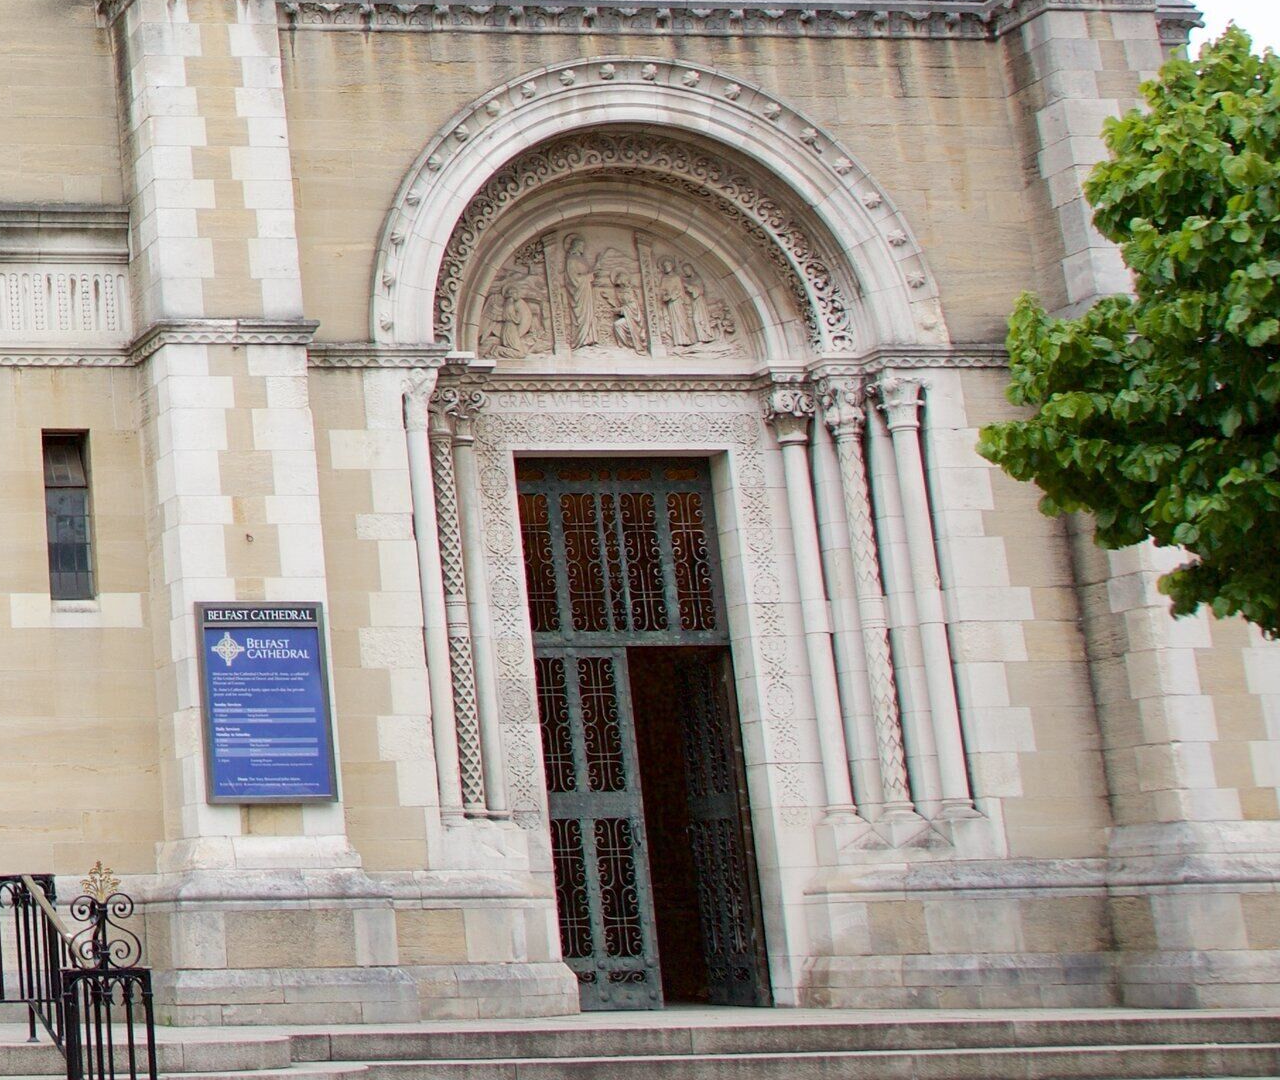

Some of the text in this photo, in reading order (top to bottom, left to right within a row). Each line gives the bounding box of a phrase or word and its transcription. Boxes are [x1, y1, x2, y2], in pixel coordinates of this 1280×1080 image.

[498, 394, 547, 408] GRAVE
[551, 393, 611, 408] WHERE
[616, 394, 629, 408] IS
[634, 394, 672, 408] THY
[678, 394, 751, 408] VICTORY
[208, 610, 312, 620] BELFAST CATHEDRAL
[246, 637, 290, 649] BELFAST
[247, 649, 310, 658] CATHEDRAL
